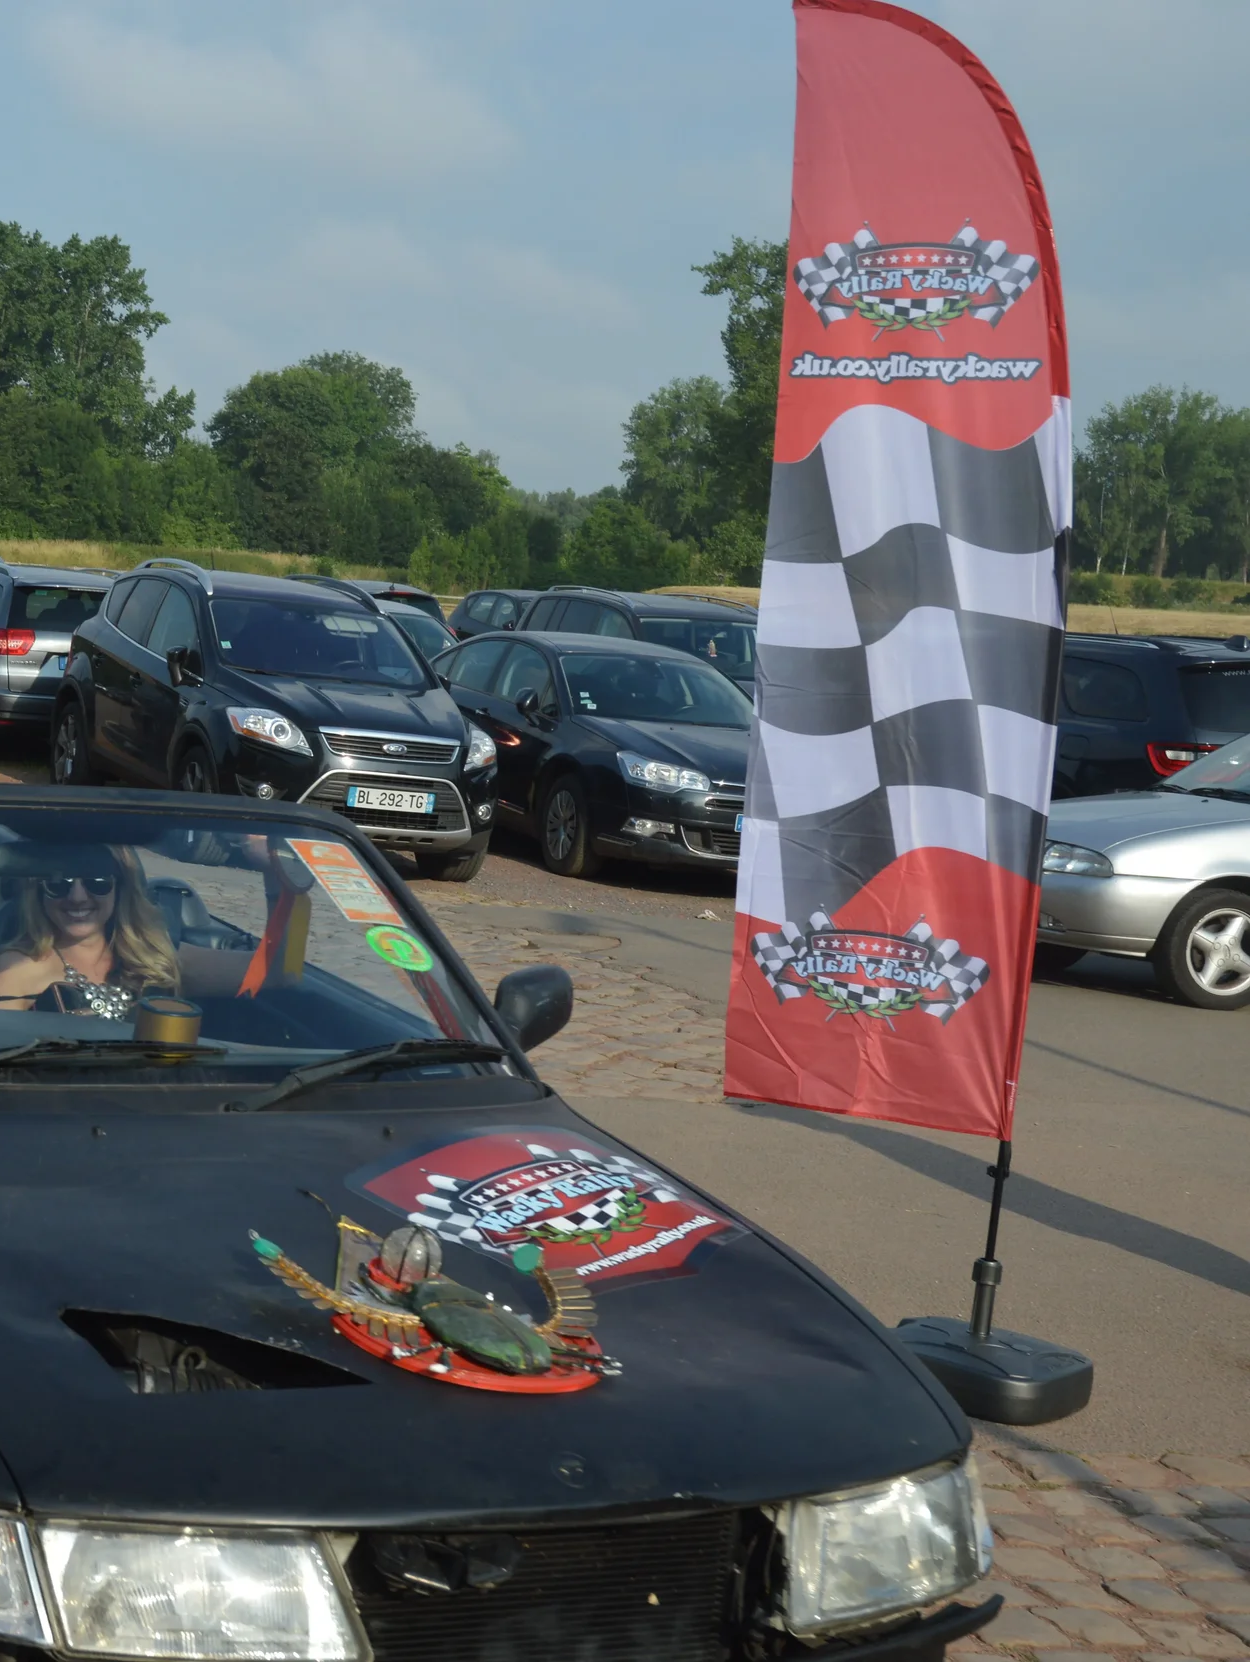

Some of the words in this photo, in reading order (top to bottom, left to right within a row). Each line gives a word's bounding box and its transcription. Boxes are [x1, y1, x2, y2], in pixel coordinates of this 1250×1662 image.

[356, 789, 425, 810] BL-292-TG
[475, 1188, 566, 1234] Wacky
[551, 1173, 637, 1199] Rally
[575, 1214, 717, 1277] www.wackyrally.co.uk
